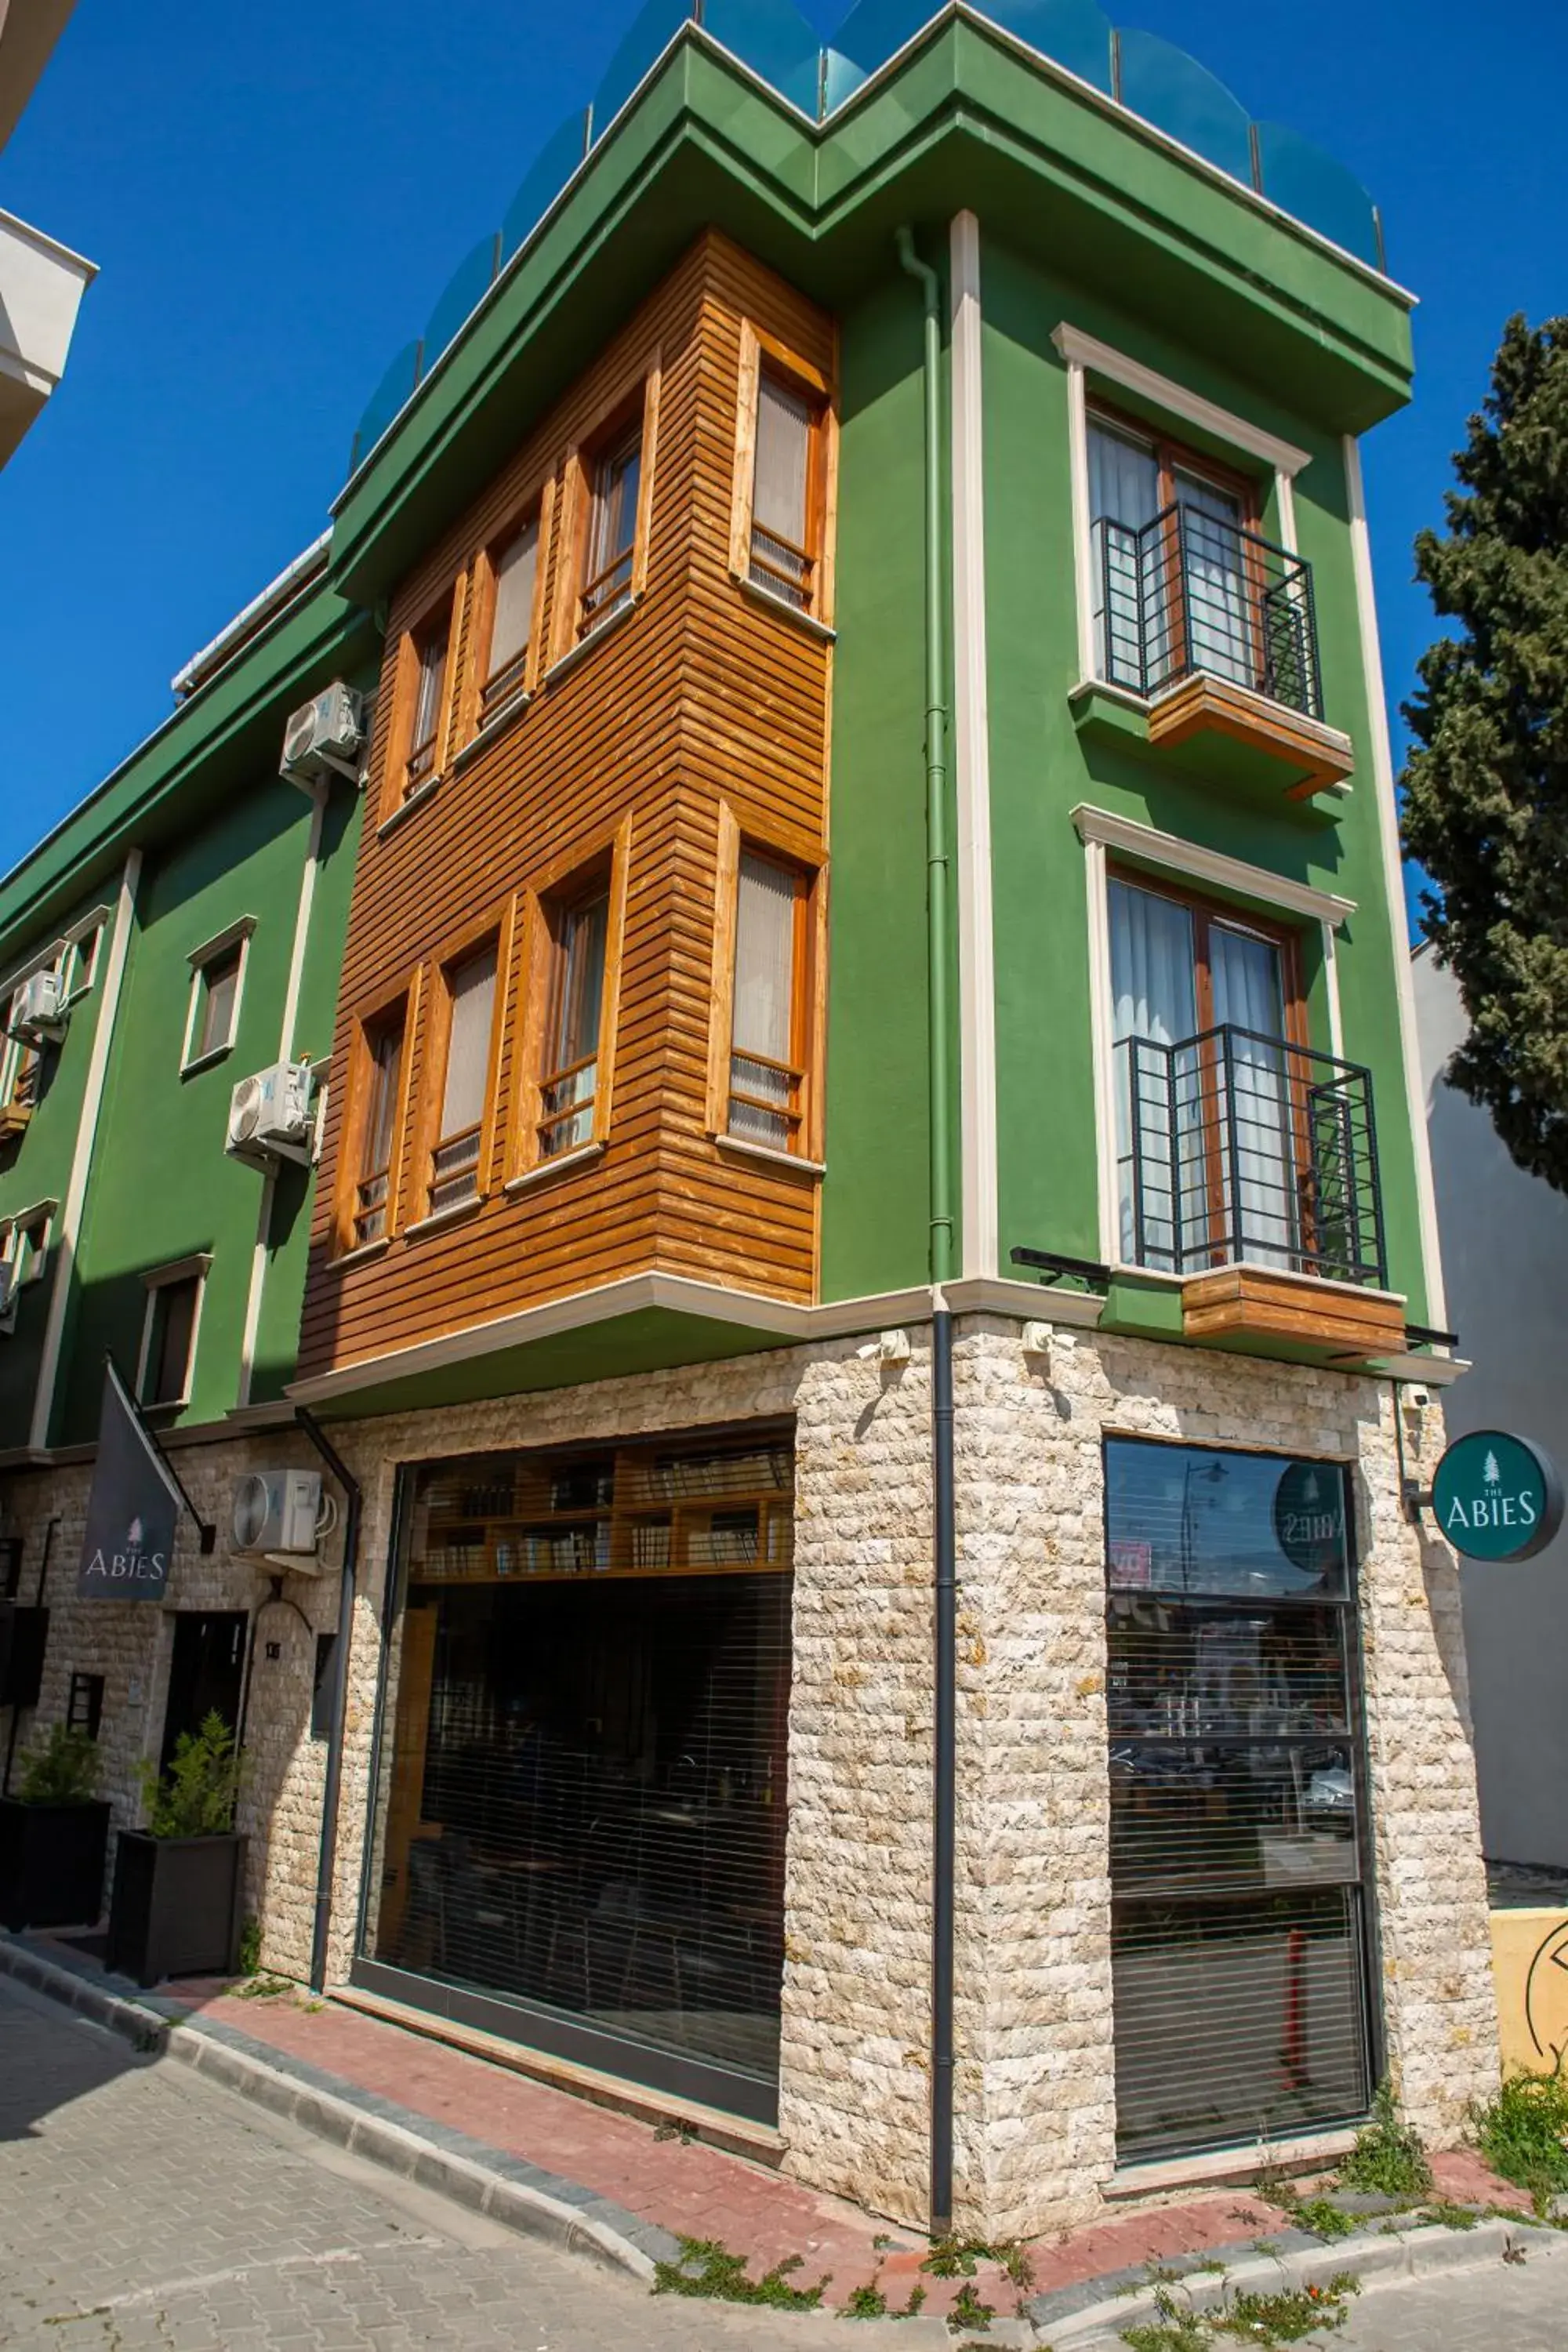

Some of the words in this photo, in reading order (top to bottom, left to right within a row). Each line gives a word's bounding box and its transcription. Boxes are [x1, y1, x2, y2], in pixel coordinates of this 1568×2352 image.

[1483, 1488, 1502, 1497] THE
[1447, 1490, 1536, 1528] ABIES
[85, 1548, 165, 1580] ABIES
